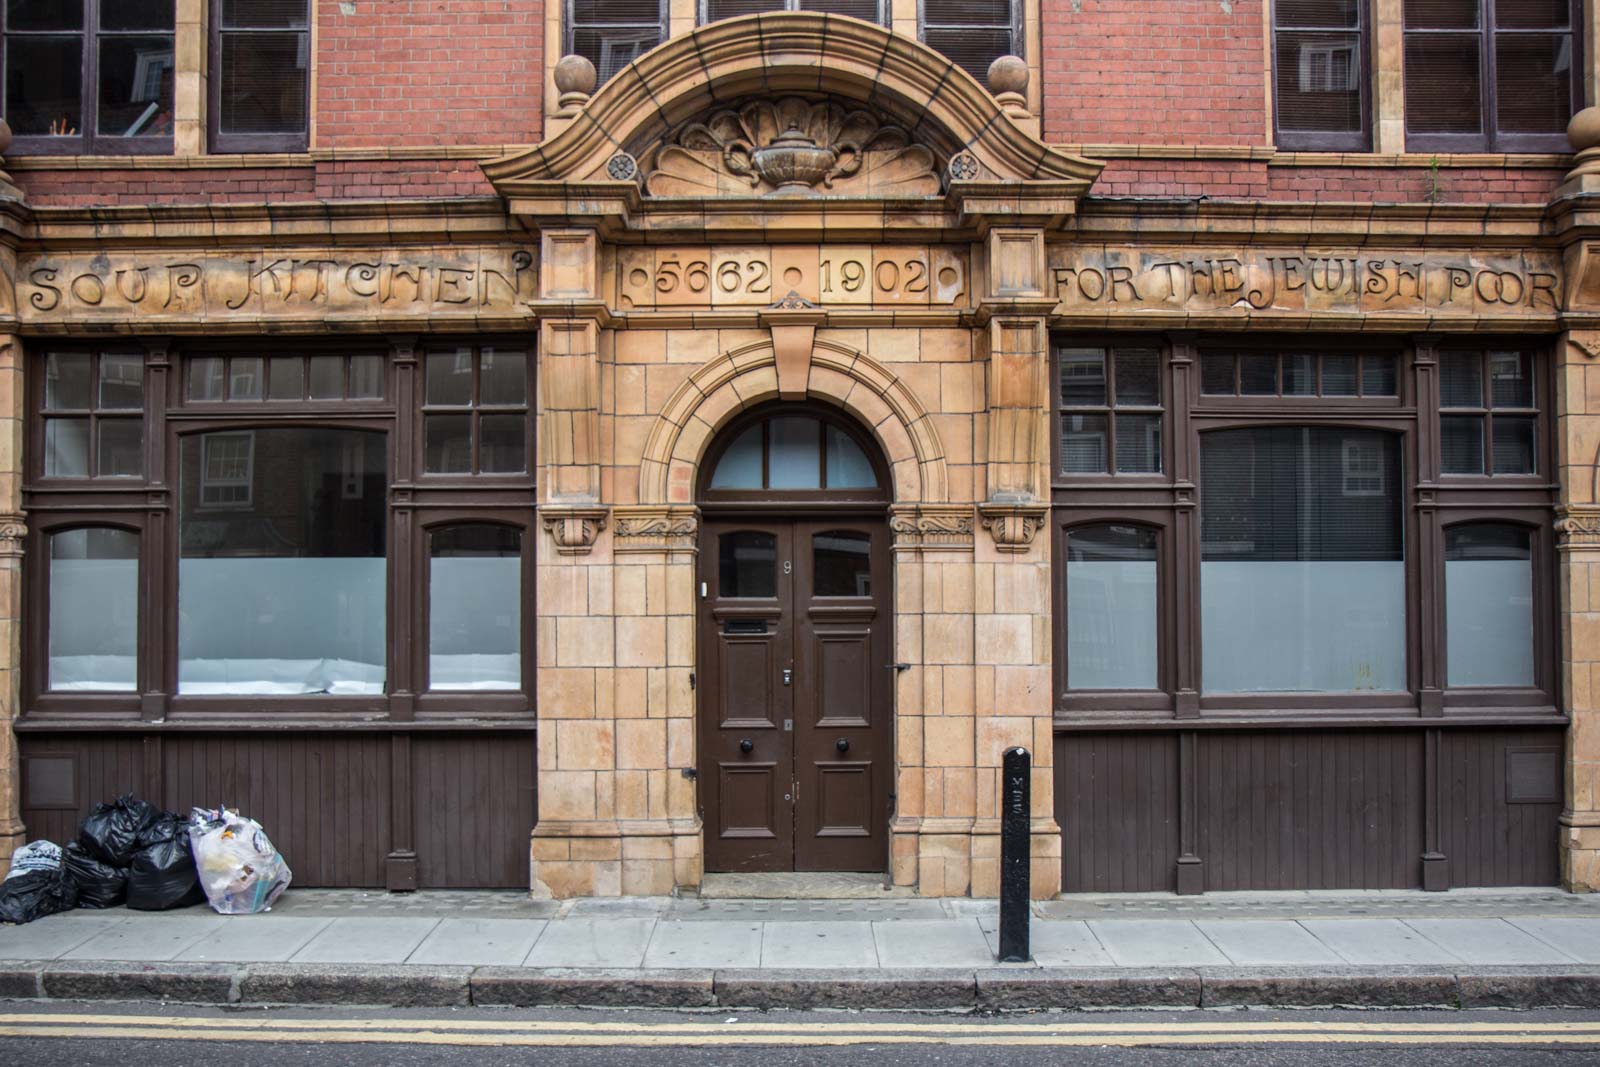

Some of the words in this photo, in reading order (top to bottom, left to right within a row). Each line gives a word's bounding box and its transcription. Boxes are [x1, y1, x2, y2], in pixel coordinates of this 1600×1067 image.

[29, 263, 202, 311] SOUP
[226, 250, 533, 310] KITCHEN
[655, 259, 771, 294] 5662
[820, 259, 930, 294] 1902
[1051, 266, 1143, 302] FOR
[1151, 259, 1245, 302] THE
[1243, 256, 1424, 310] JEWISH
[1439, 266, 1563, 312] POOR
[784, 561, 791, 574] 9
